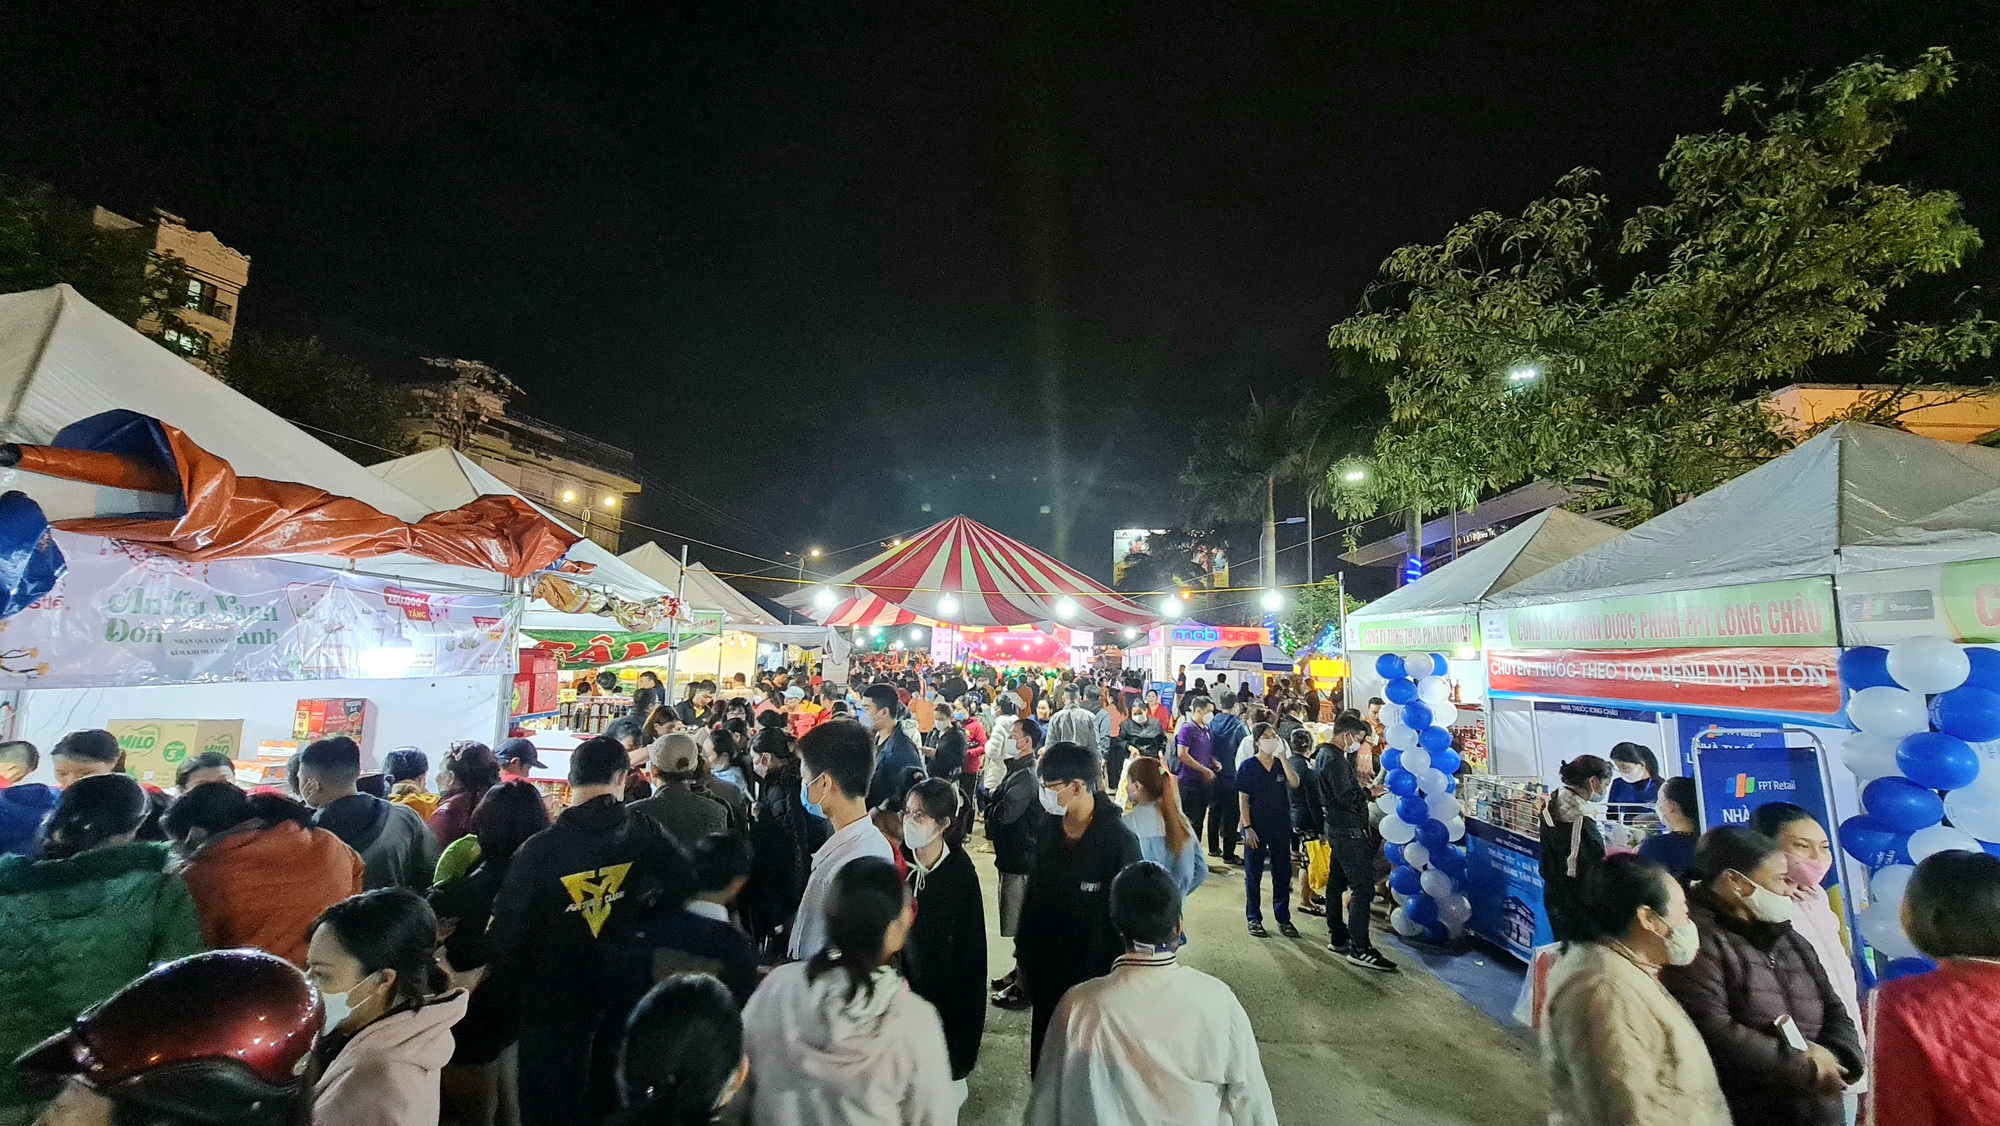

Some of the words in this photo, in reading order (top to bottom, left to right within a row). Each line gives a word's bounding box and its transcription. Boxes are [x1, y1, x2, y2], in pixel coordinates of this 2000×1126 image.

[1716, 601, 1764, 637] LONG
[1767, 591, 1823, 635] CHÂU
[235, 628, 279, 646] anh
[1173, 626, 1261, 642] mobifone
[1531, 656, 1577, 678] THUỐC
[1580, 662, 1618, 680] THEO
[1623, 663, 1656, 682] TOA
[1660, 657, 1709, 689] BỆNH
[1714, 658, 1766, 692] VIỆN
[1773, 658, 1829, 688] LỚN
[118, 734, 156, 750] MILO
[1758, 780, 1773, 791] FPT
[1773, 779, 1796, 791] Retail
